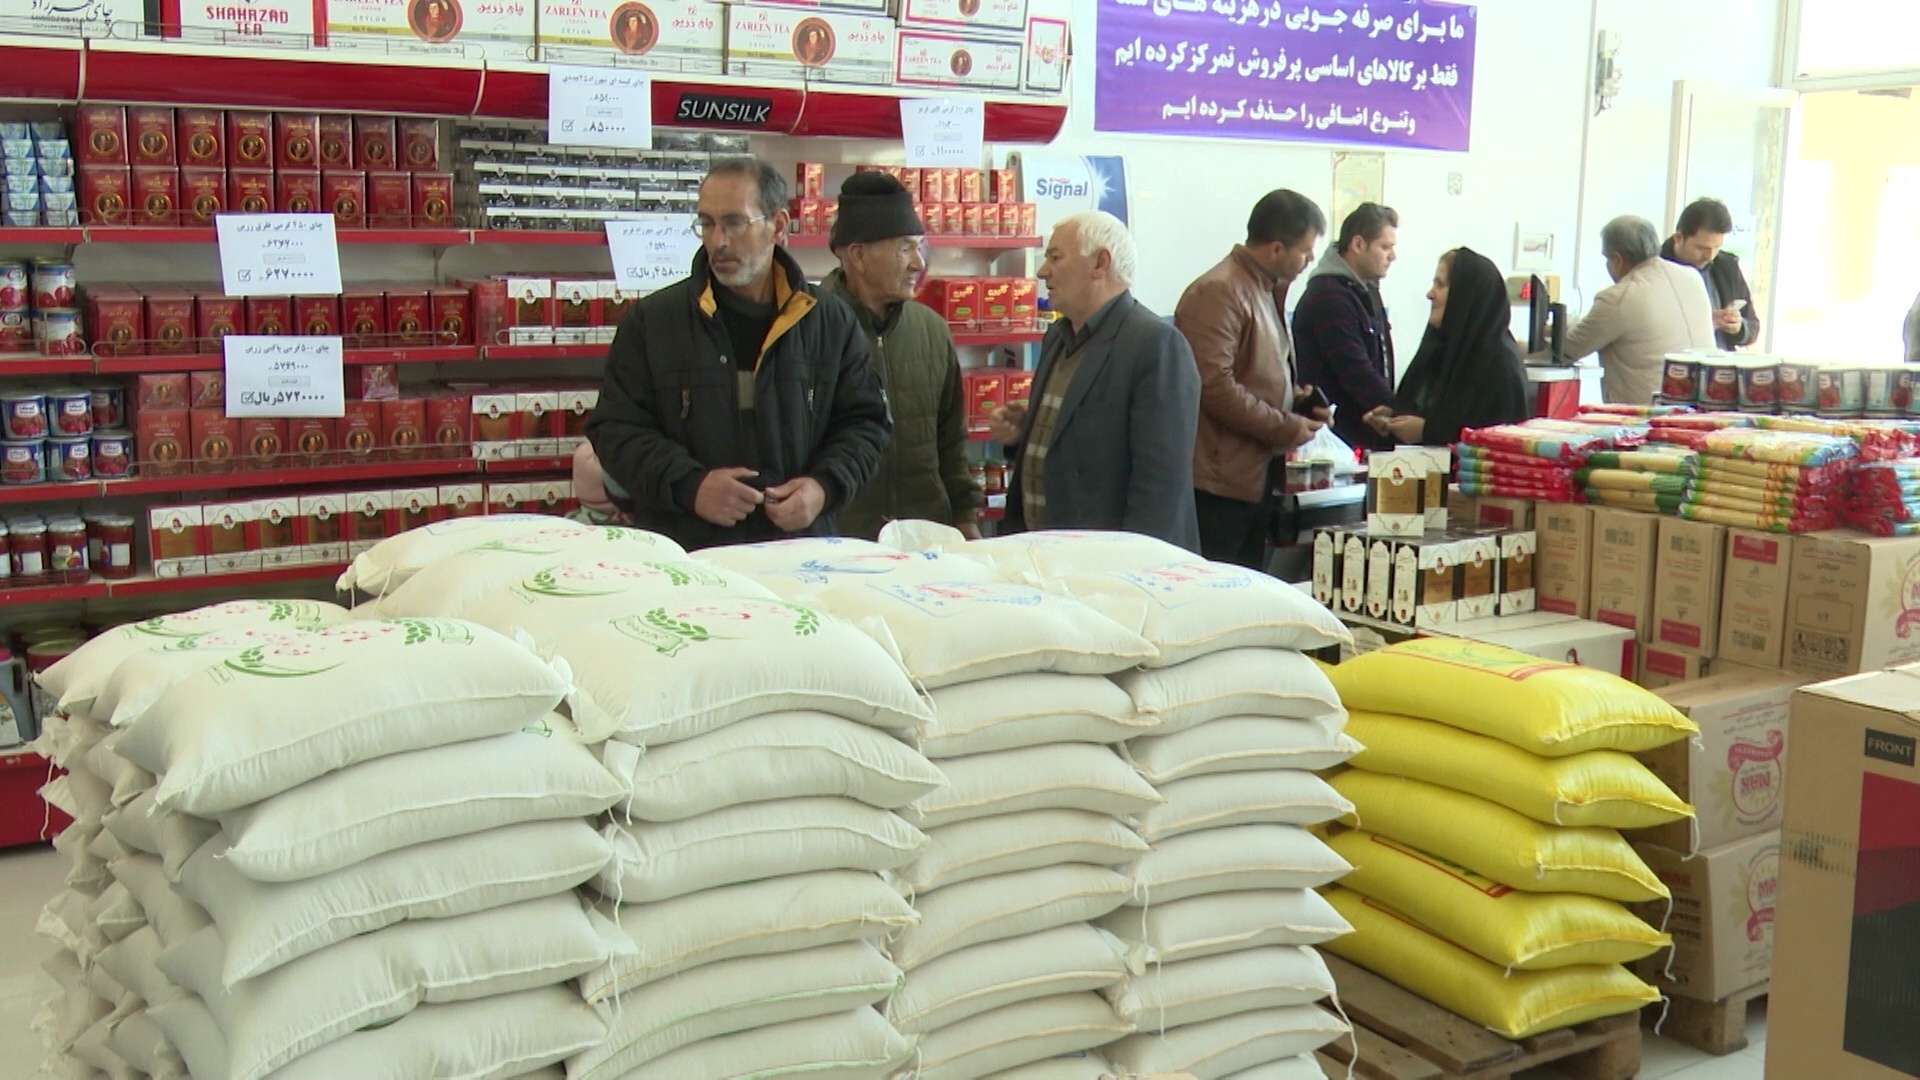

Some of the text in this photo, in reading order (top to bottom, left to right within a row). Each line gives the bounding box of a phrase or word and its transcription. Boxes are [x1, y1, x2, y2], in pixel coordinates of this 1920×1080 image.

[206, 6, 289, 24] SHAHRZAD
[544, 6, 608, 20] ZAREEN TEA
[1284, 5, 1349, 34] جویی
[1351, 2, 1394, 38] صرفه
[1449, 13, 1465, 39] ما
[235, 21, 263, 36] TEA
[735, 21, 790, 34] ZAREEN TEA
[1396, 9, 1447, 45] برای
[1115, 36, 1142, 66] ایم
[1144, 41, 1189, 72] کرده
[1304, 53, 1355, 82] اساسی
[1357, 57, 1415, 87] کالاهای
[1429, 62, 1459, 87] فقط
[678, 99, 770, 122] SUNSILK
[1162, 95, 1197, 120] ایم
[1199, 98, 1248, 124] کرده
[1249, 98, 1298, 122] حذف
[1300, 102, 1314, 129] را
[1315, 102, 1368, 130] اضافی
[1036, 177, 1088, 200] Signal
[1867, 737, 1913, 758] FRONT
